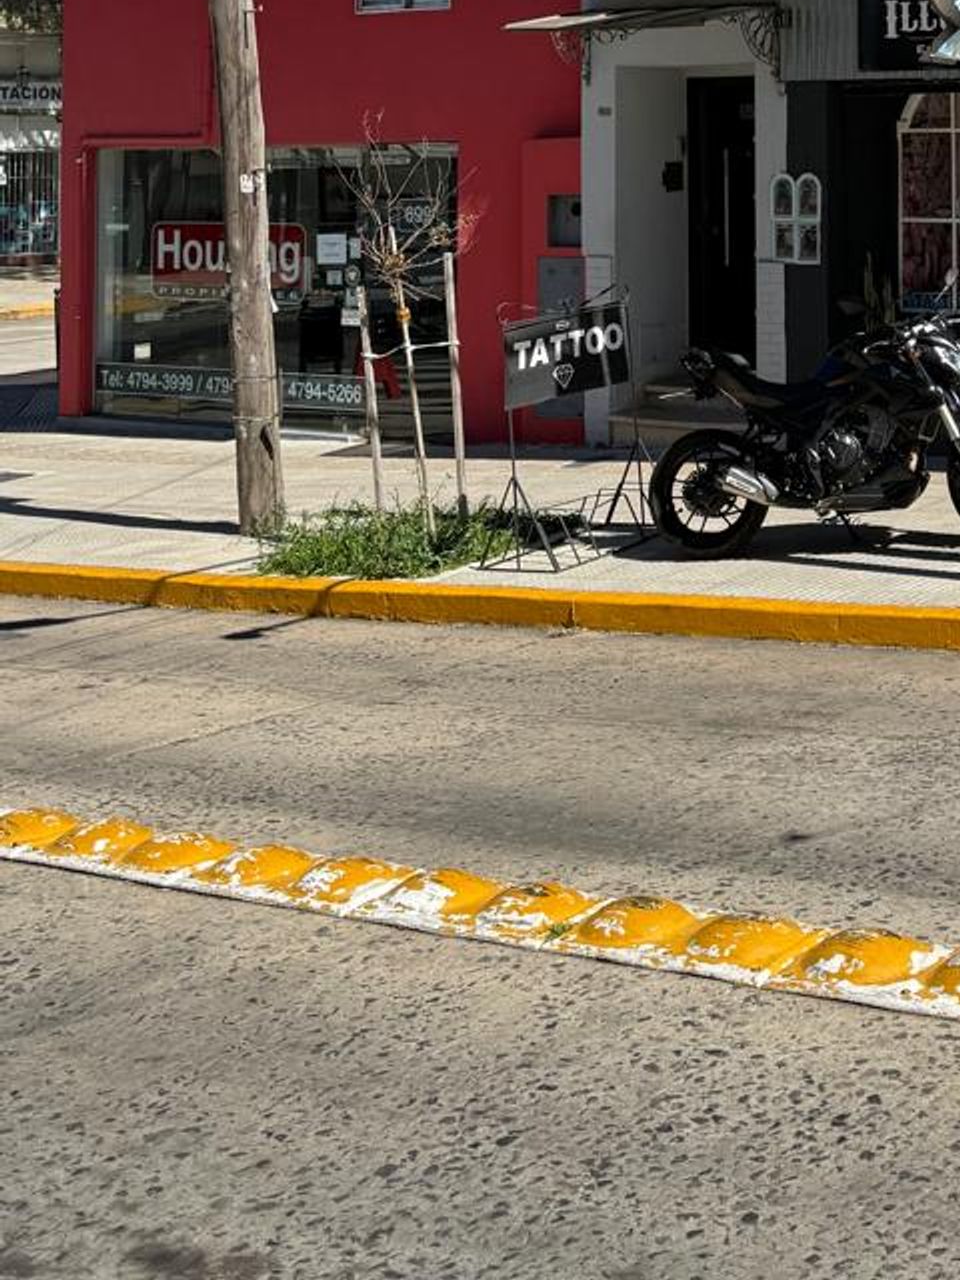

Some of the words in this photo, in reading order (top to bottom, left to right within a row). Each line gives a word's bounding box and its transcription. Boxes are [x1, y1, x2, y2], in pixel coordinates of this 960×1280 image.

[157, 228, 300, 284] Houg
[159, 286, 299, 301] PROPIEES
[513, 322, 623, 370] TATTOO
[100, 369, 124, 389] Tel:
[126, 371, 194, 392] 4794-3999
[287, 380, 362, 404] 4794-5266
